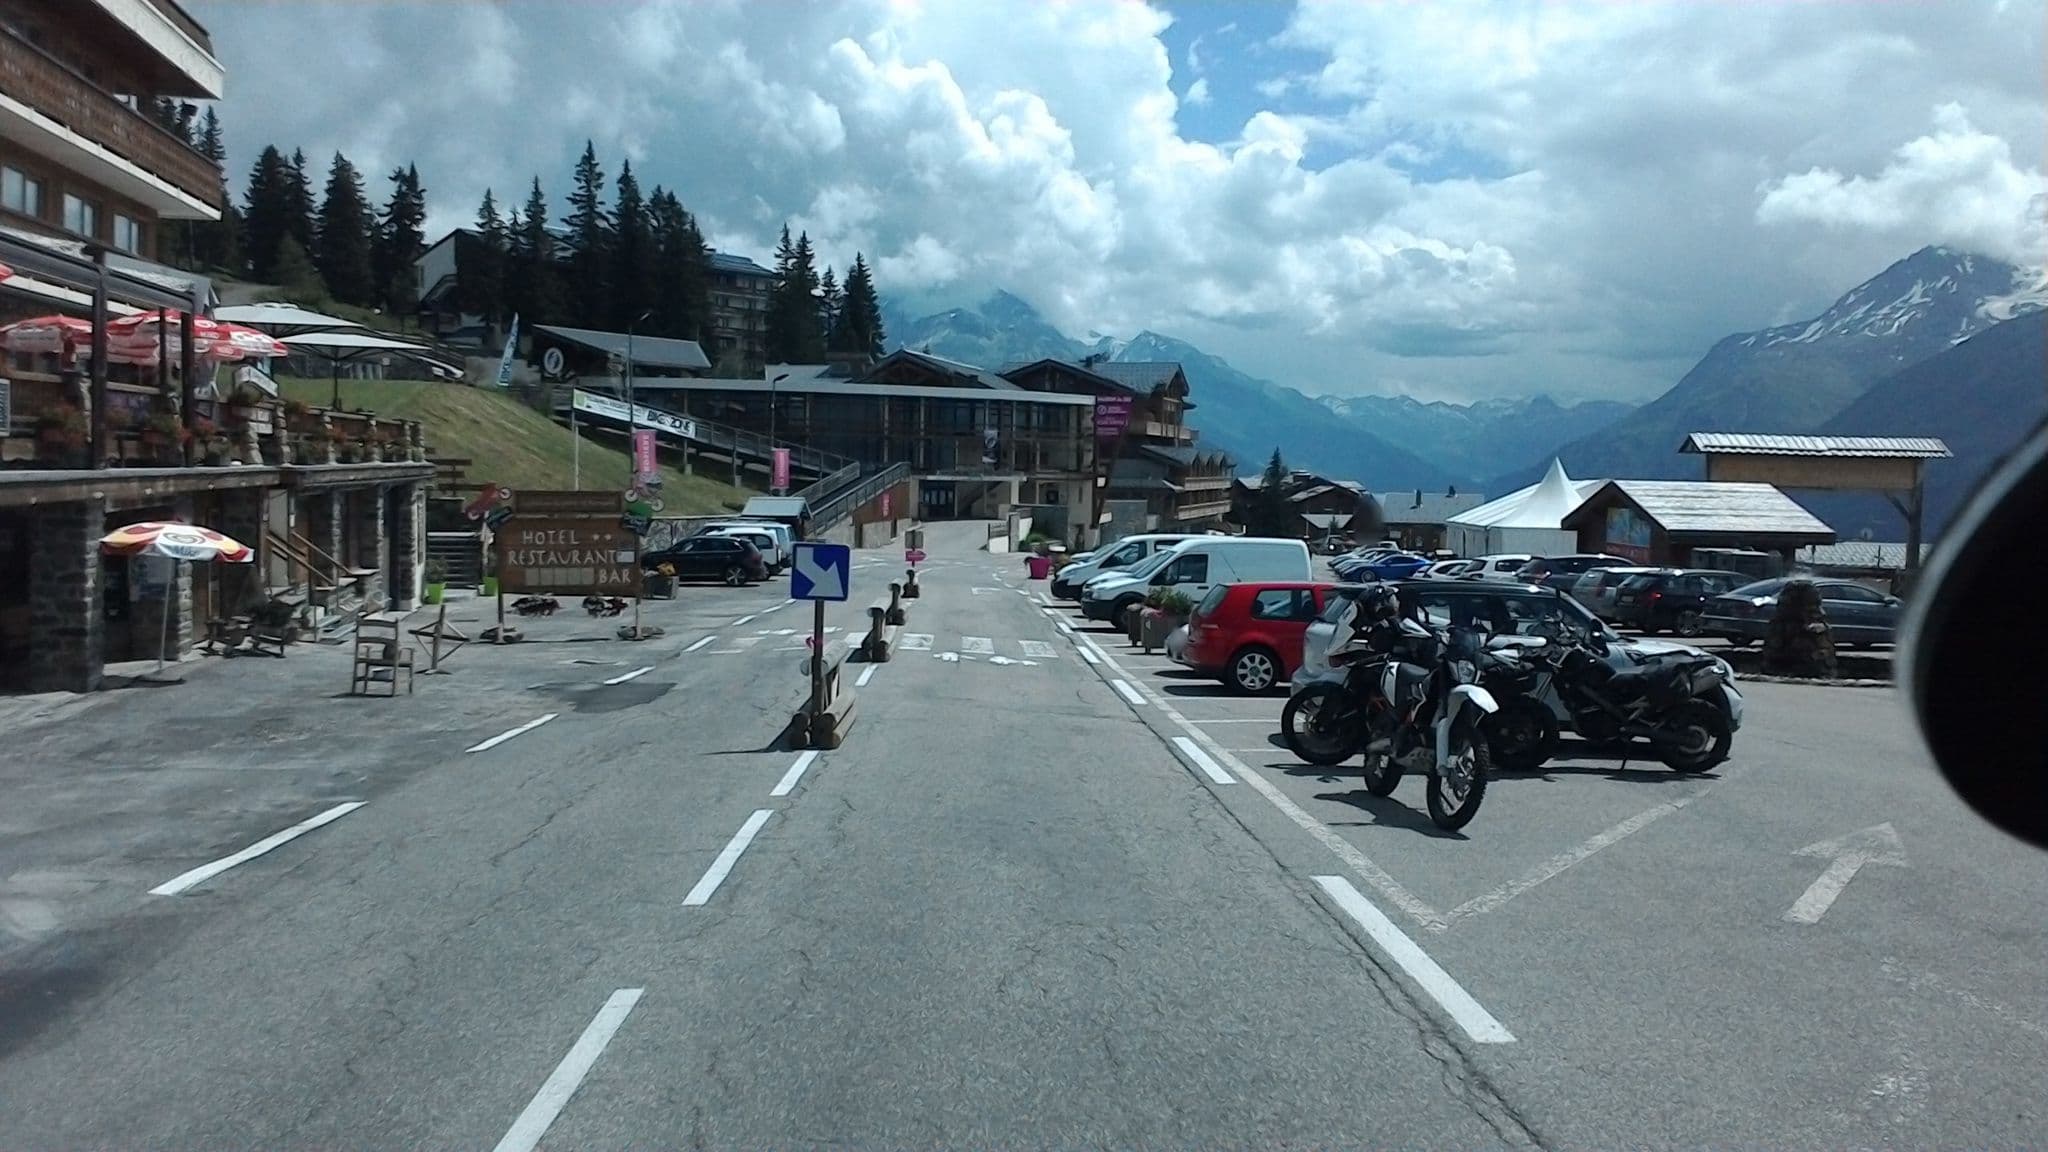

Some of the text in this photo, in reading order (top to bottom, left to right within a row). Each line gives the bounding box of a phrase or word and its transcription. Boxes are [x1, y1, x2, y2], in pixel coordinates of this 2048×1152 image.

[522, 530, 580, 545] HOTEL
[508, 550, 616, 566] RESTAURANT
[599, 569, 632, 584] BAR
